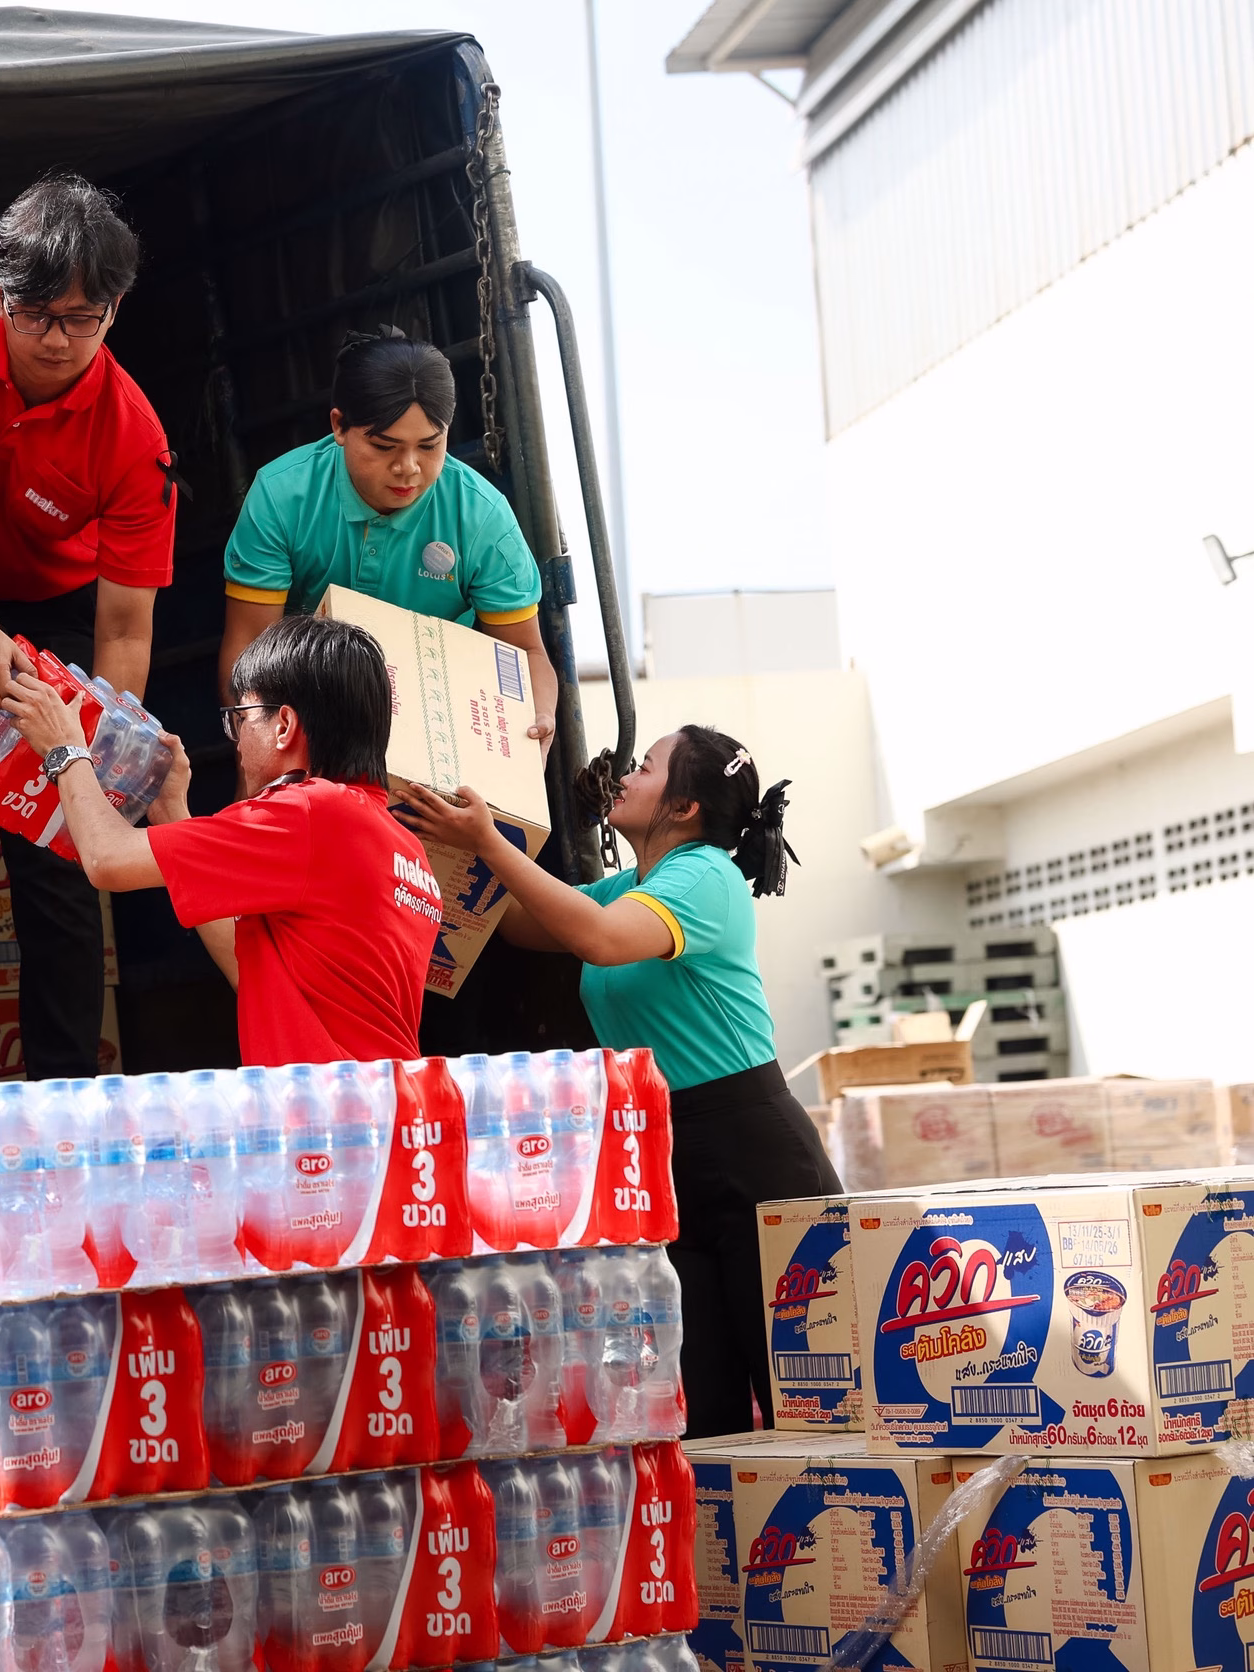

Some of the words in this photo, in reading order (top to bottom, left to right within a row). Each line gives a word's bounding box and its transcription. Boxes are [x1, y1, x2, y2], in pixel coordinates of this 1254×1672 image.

[25, 487, 69, 522] makro
[480, 689, 487, 702] UP
[470, 699, 482, 735] ด้านบน
[482, 706, 490, 728] SIDE
[485, 732, 493, 752] THIS
[1, 790, 37, 819] ขวด
[393, 851, 441, 899] makro
[394, 883, 442, 924] คู่คิดธุรกิจคุณ
[401, 1108, 442, 1150] เพิ่ม
[612, 1094, 647, 1133] เพิ่ม
[301, 1157, 329, 1171] aro
[522, 1139, 548, 1153] aro
[623, 1133, 640, 1187] 3
[411, 1150, 436, 1202] 3
[402, 1204, 446, 1227] ขวด
[614, 1188, 651, 1212] ขวด
[776, 1263, 820, 1300] ควิก
[897, 1236, 998, 1319] ควิก
[1157, 1260, 1201, 1304] ควิก
[369, 1315, 410, 1354] เพิ่ม
[128, 1336, 176, 1379] เพิ่ม
[265, 1365, 292, 1382] aro
[16, 1392, 46, 1407] aro
[379, 1357, 403, 1410] 3
[140, 1379, 167, 1436] 3
[368, 1413, 413, 1438] ขวด
[129, 1438, 179, 1464] ขวด
[640, 1489, 672, 1526] เพิ่ม
[428, 1513, 469, 1553] เพิ่ม
[552, 1540, 576, 1555] aro
[749, 1526, 796, 1566] ควิก
[971, 1528, 1018, 1568] ควิก
[650, 1528, 665, 1578] 3
[325, 1570, 351, 1585] aro
[438, 1557, 461, 1610] 3
[641, 1581, 674, 1604] ขวด
[427, 1611, 471, 1635] ขวด
